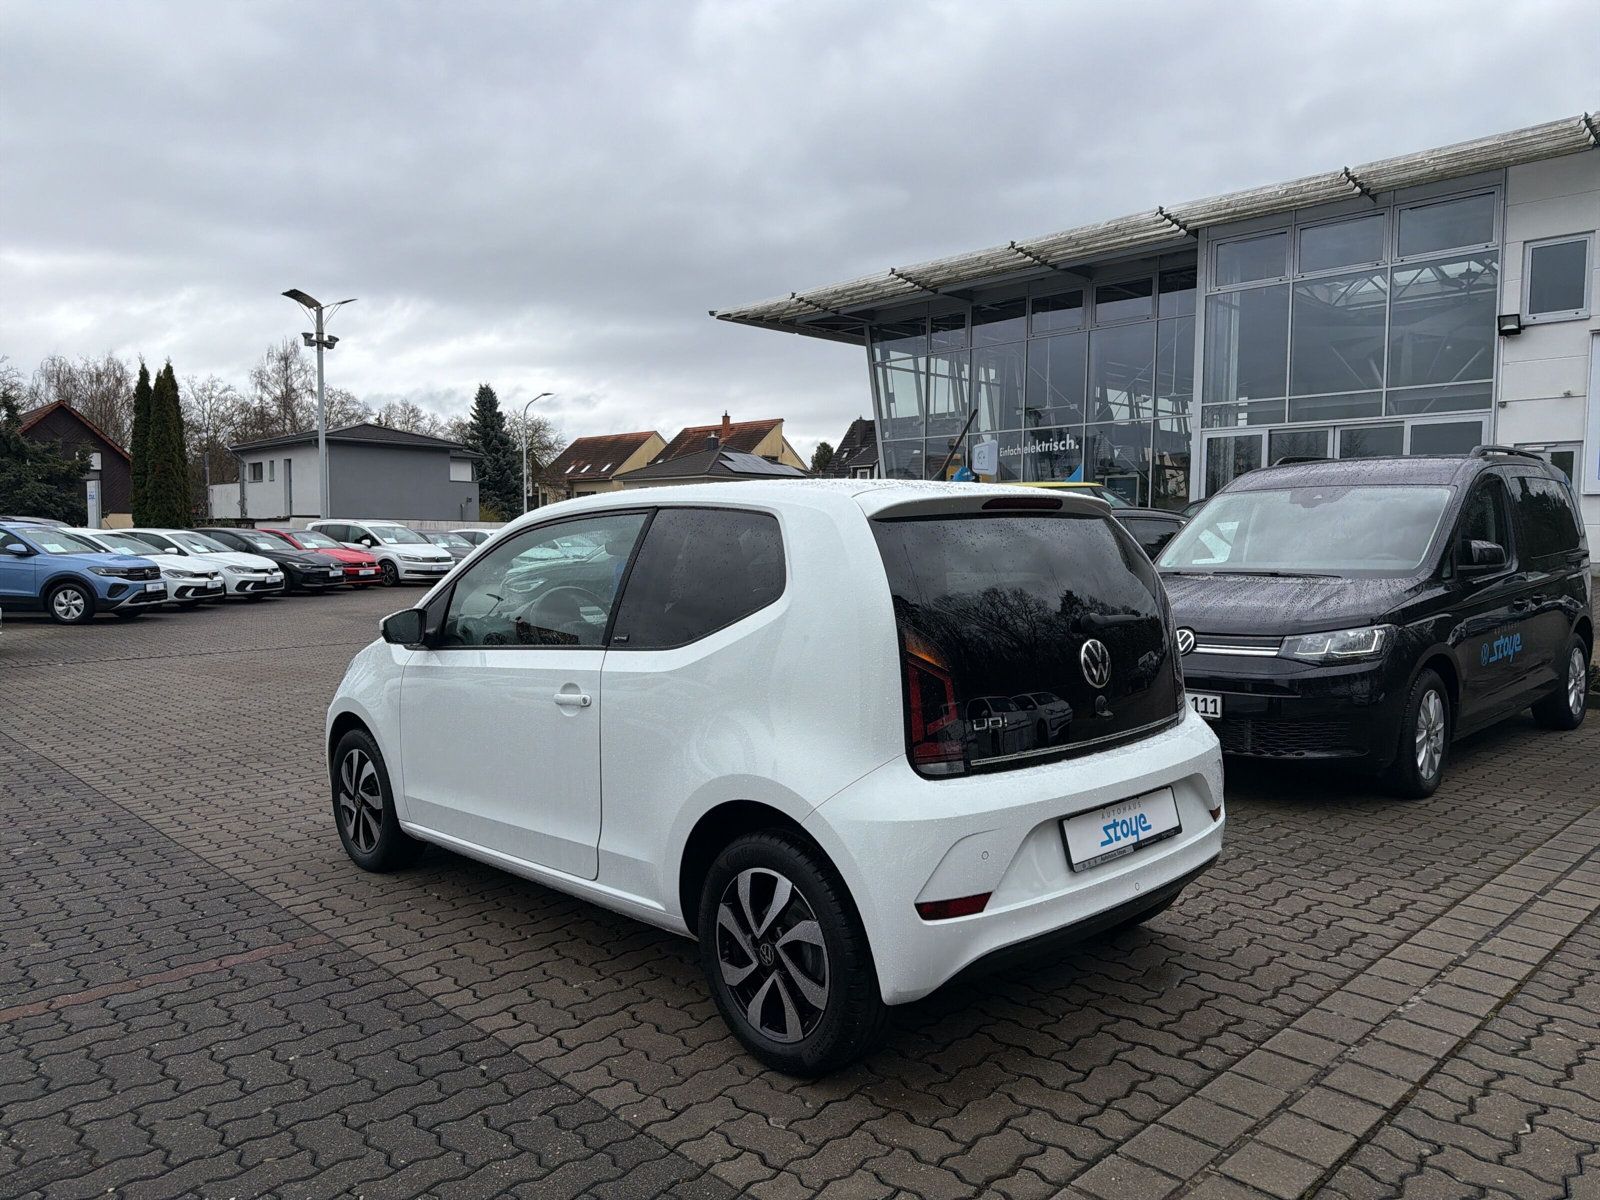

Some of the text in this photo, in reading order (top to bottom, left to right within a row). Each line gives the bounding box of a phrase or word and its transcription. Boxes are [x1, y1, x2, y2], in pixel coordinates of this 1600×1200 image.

[1000, 433, 1080, 457] Einfach elektrisch.
[1191, 696, 1219, 715] 111
[973, 712, 1007, 733] up!
[1101, 801, 1142, 819] AUTOHAUS
